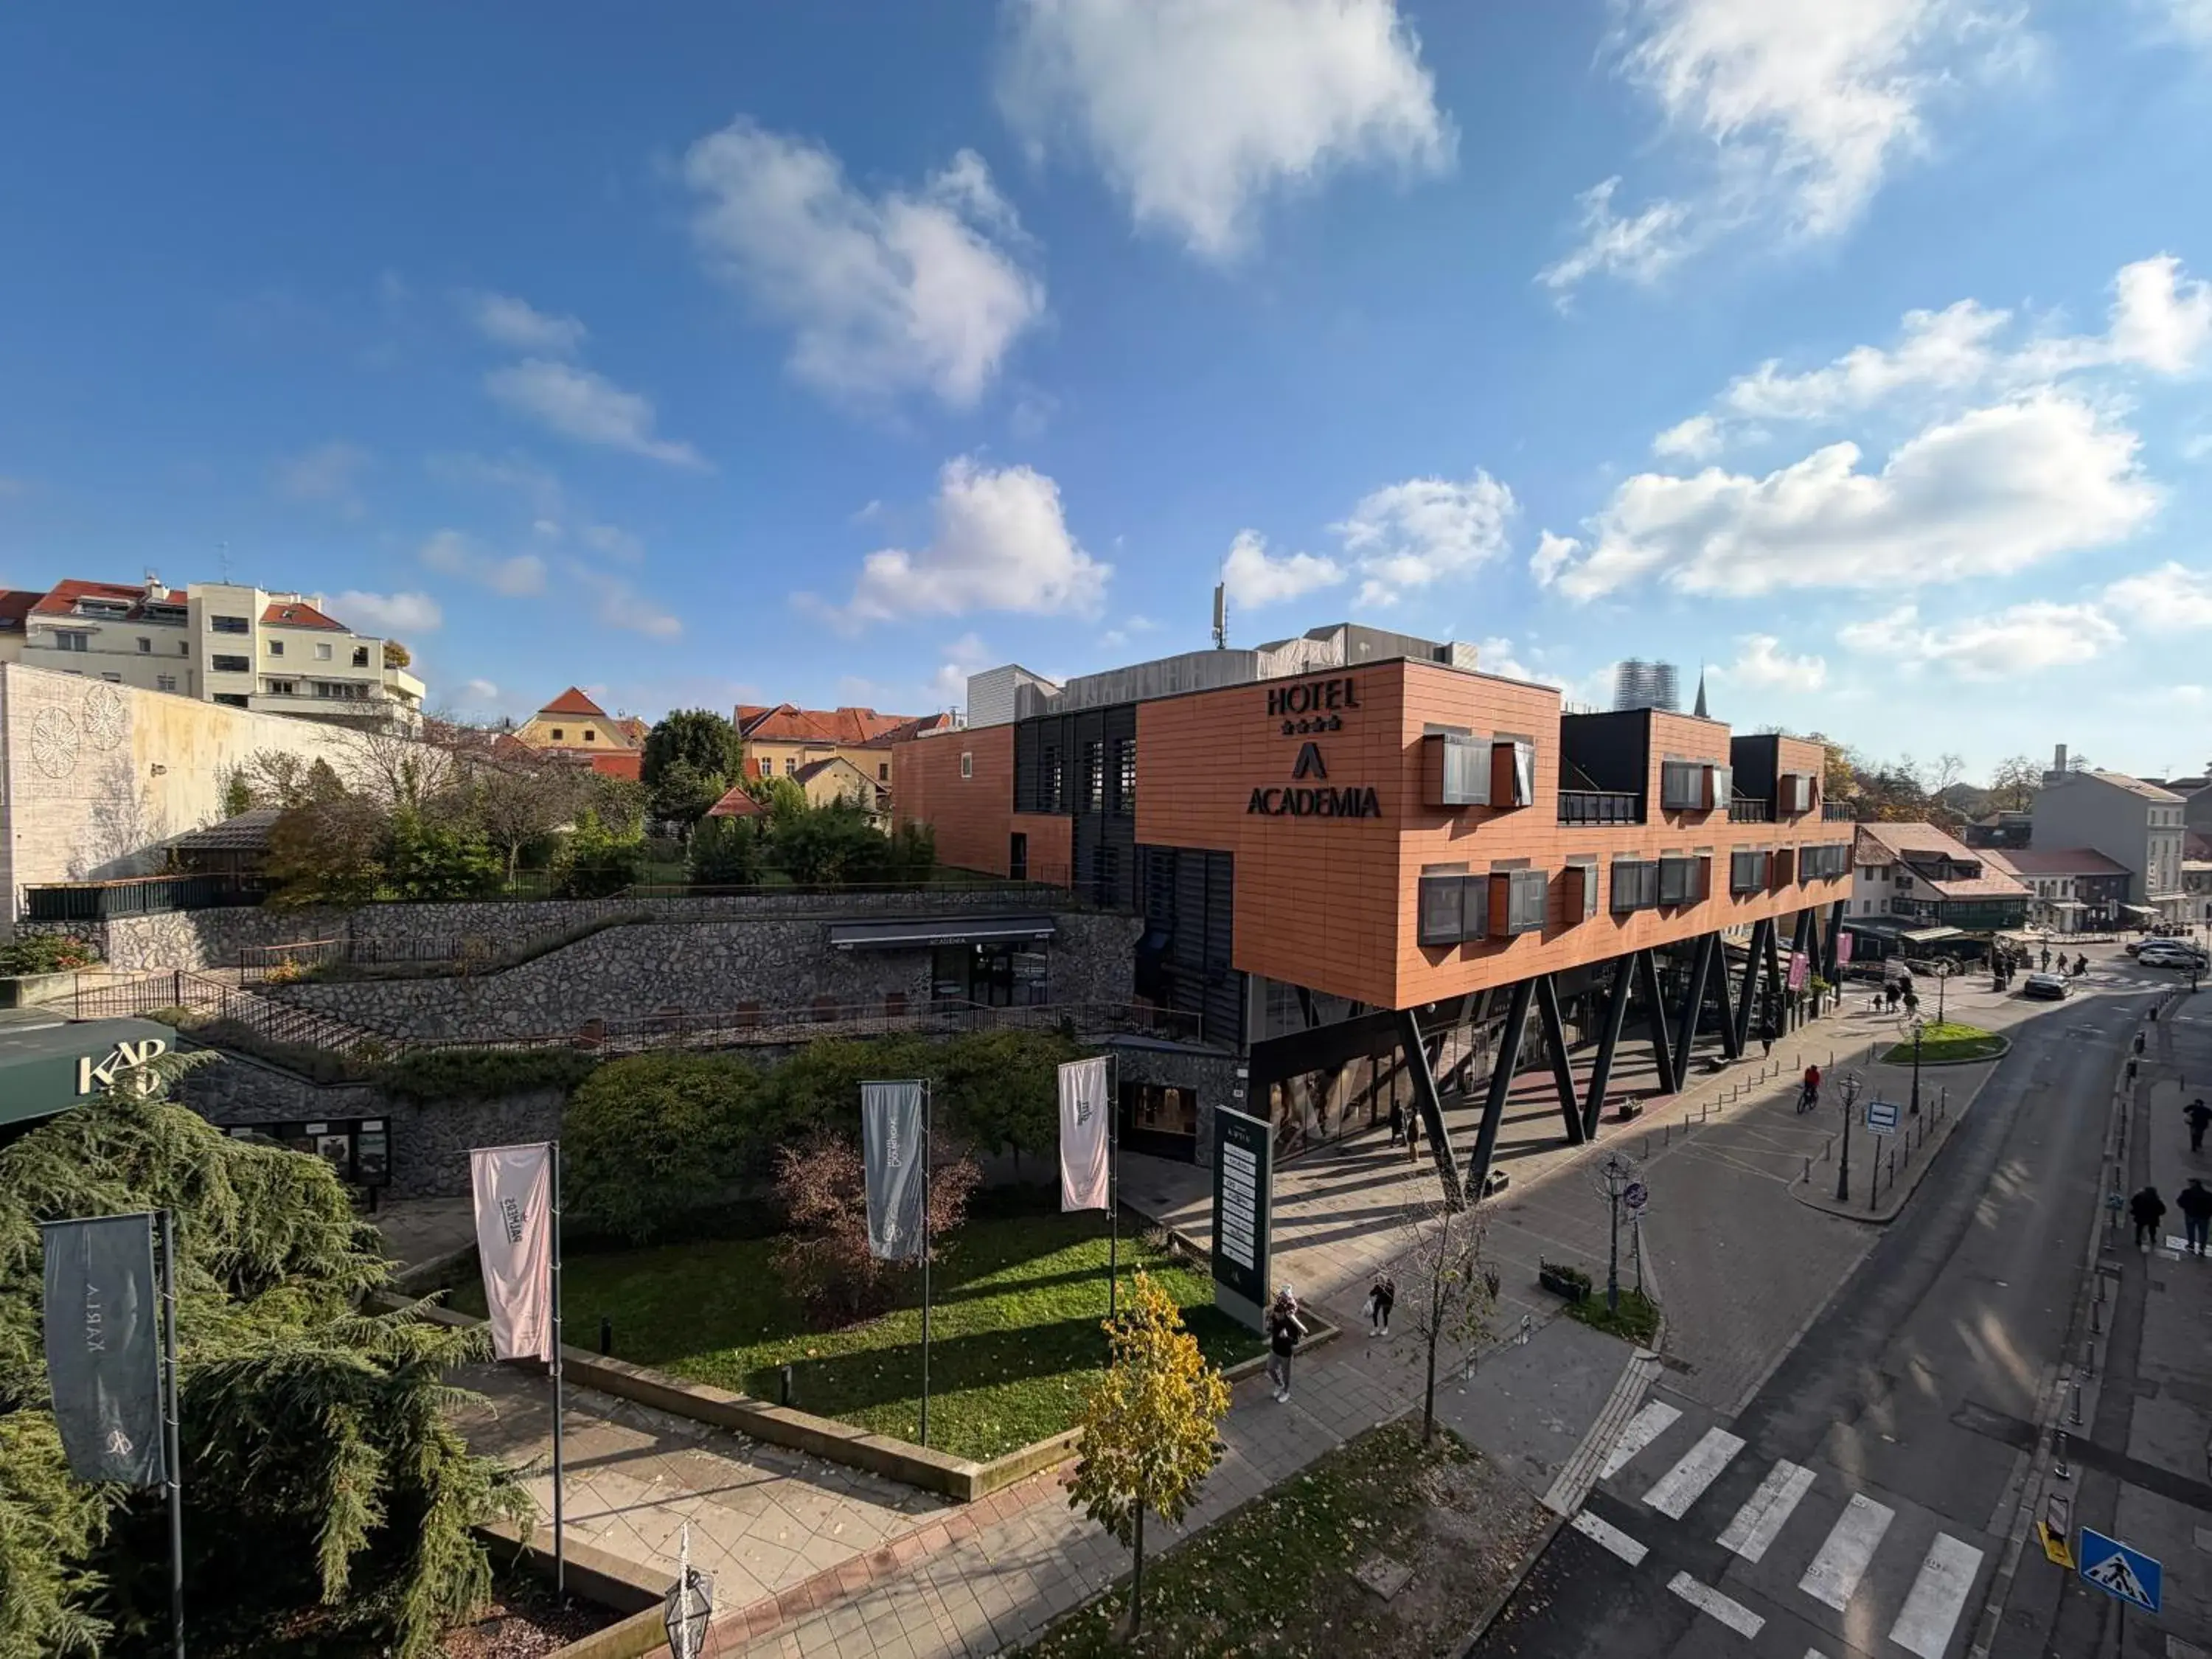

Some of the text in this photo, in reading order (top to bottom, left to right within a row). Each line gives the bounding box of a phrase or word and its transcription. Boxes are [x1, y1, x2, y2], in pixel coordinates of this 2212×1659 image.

[1268, 678, 1360, 715] HOTEL
[1248, 787, 1382, 818] ACADEMIA
[80, 1039, 166, 1094] KAP
